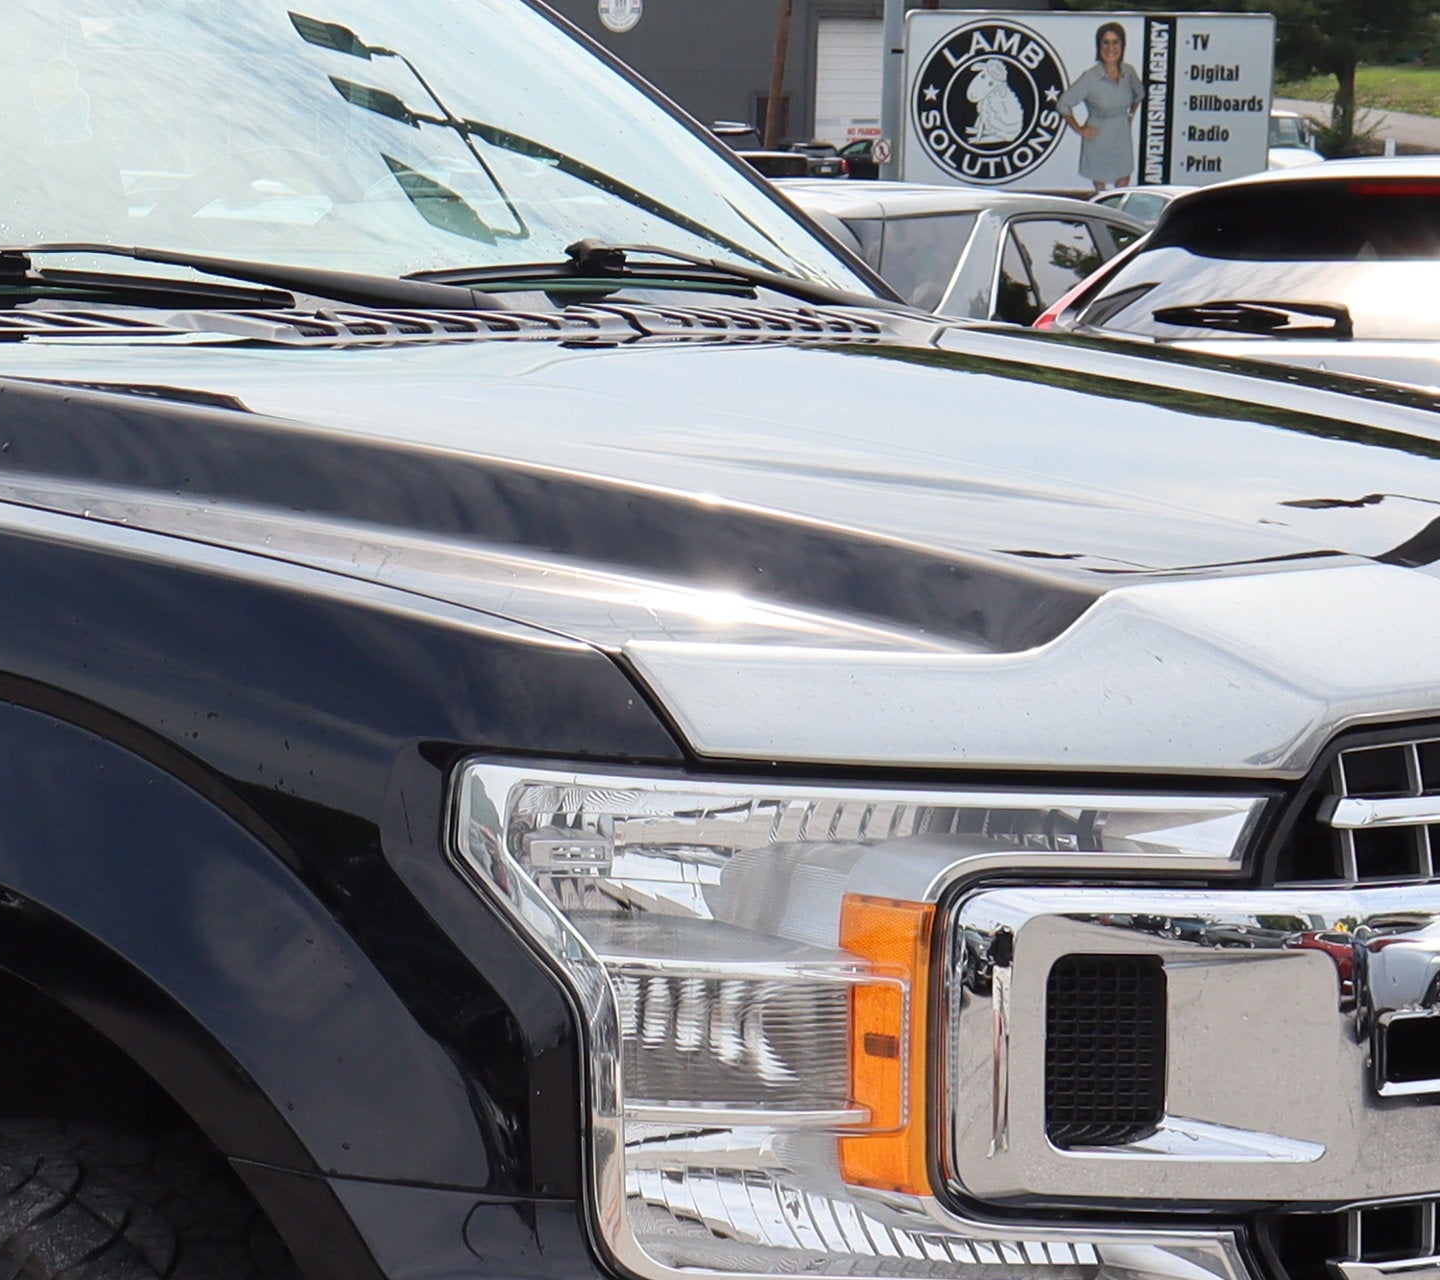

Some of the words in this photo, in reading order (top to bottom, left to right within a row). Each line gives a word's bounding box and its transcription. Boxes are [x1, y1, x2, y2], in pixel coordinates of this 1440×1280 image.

[942, 28, 1046, 70] LAMB
[1149, 20, 1169, 82] AGENCY
[1192, 34, 1210, 51] TV
[1190, 64, 1239, 83] Digital
[1188, 95, 1264, 112] Billboards
[1144, 83, 1167, 184] ADVERTISING
[1187, 124, 1230, 142] Radio
[921, 109, 1060, 177] SOLUTIONS
[1185, 155, 1223, 173] Print
